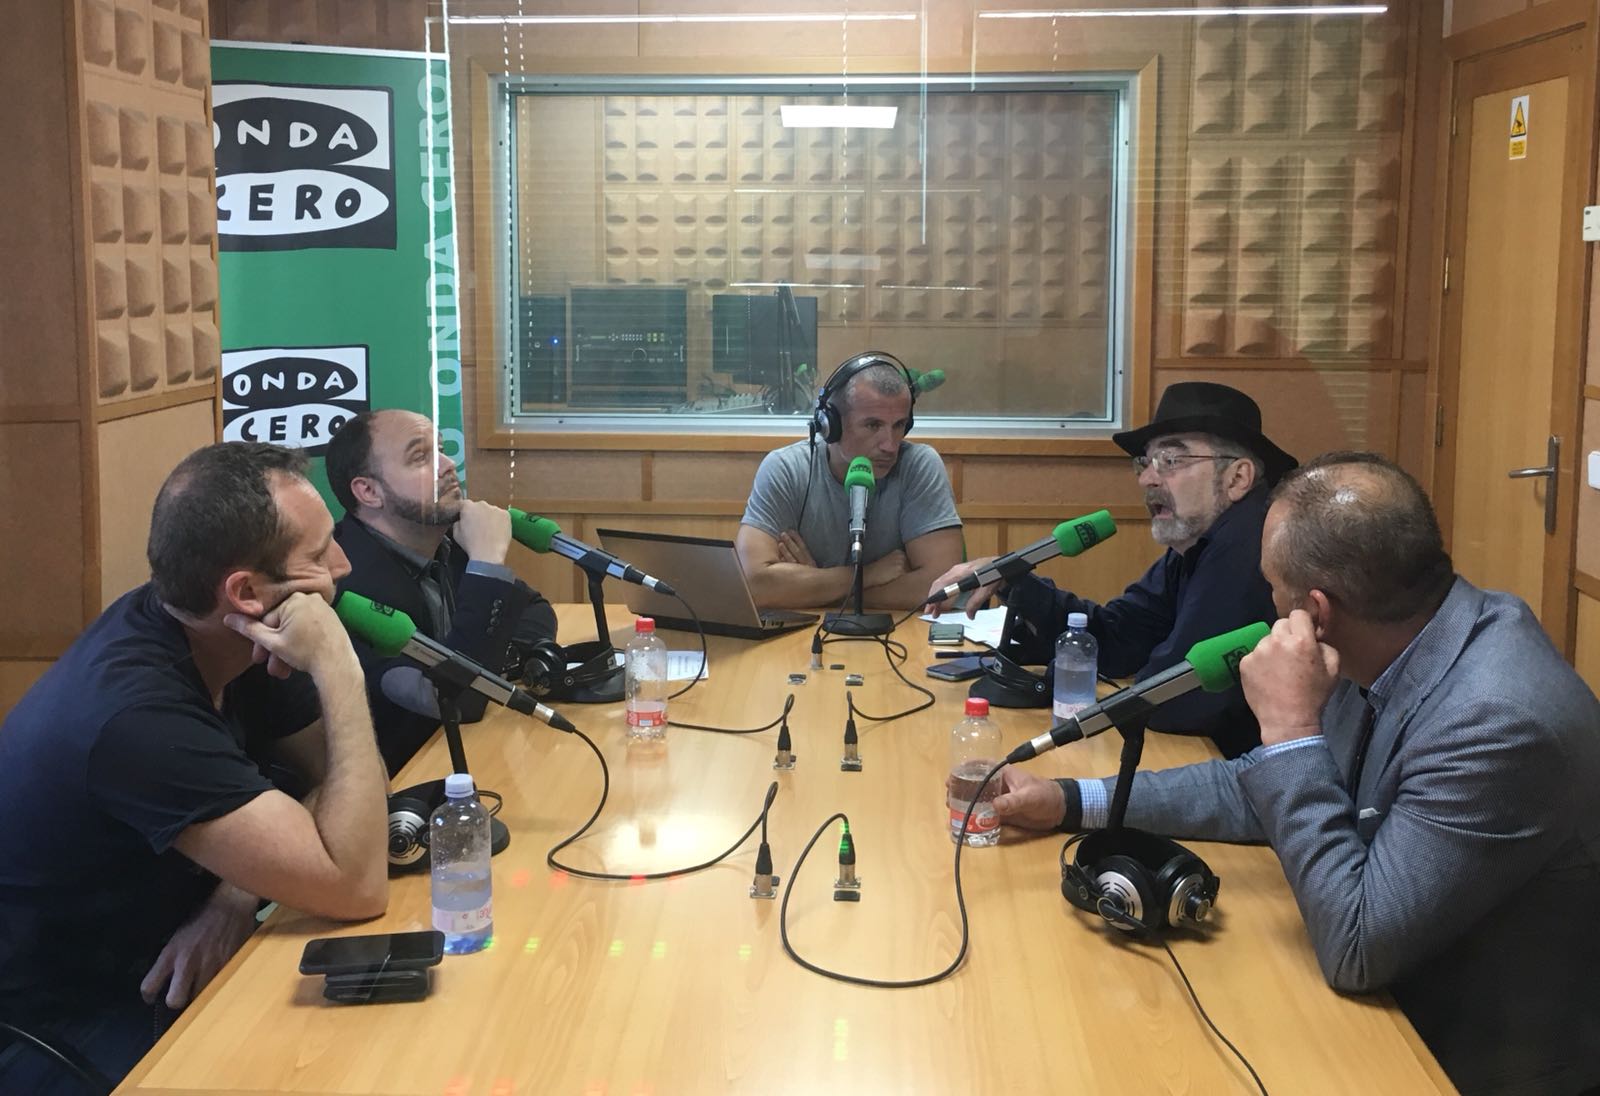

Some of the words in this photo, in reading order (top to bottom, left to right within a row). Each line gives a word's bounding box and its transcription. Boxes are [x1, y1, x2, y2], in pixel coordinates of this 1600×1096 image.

[417, 74, 454, 212] CERO
[424, 232, 461, 396] ONDA
[232, 370, 344, 396] ONDA
[241, 414, 347, 441] CERO
